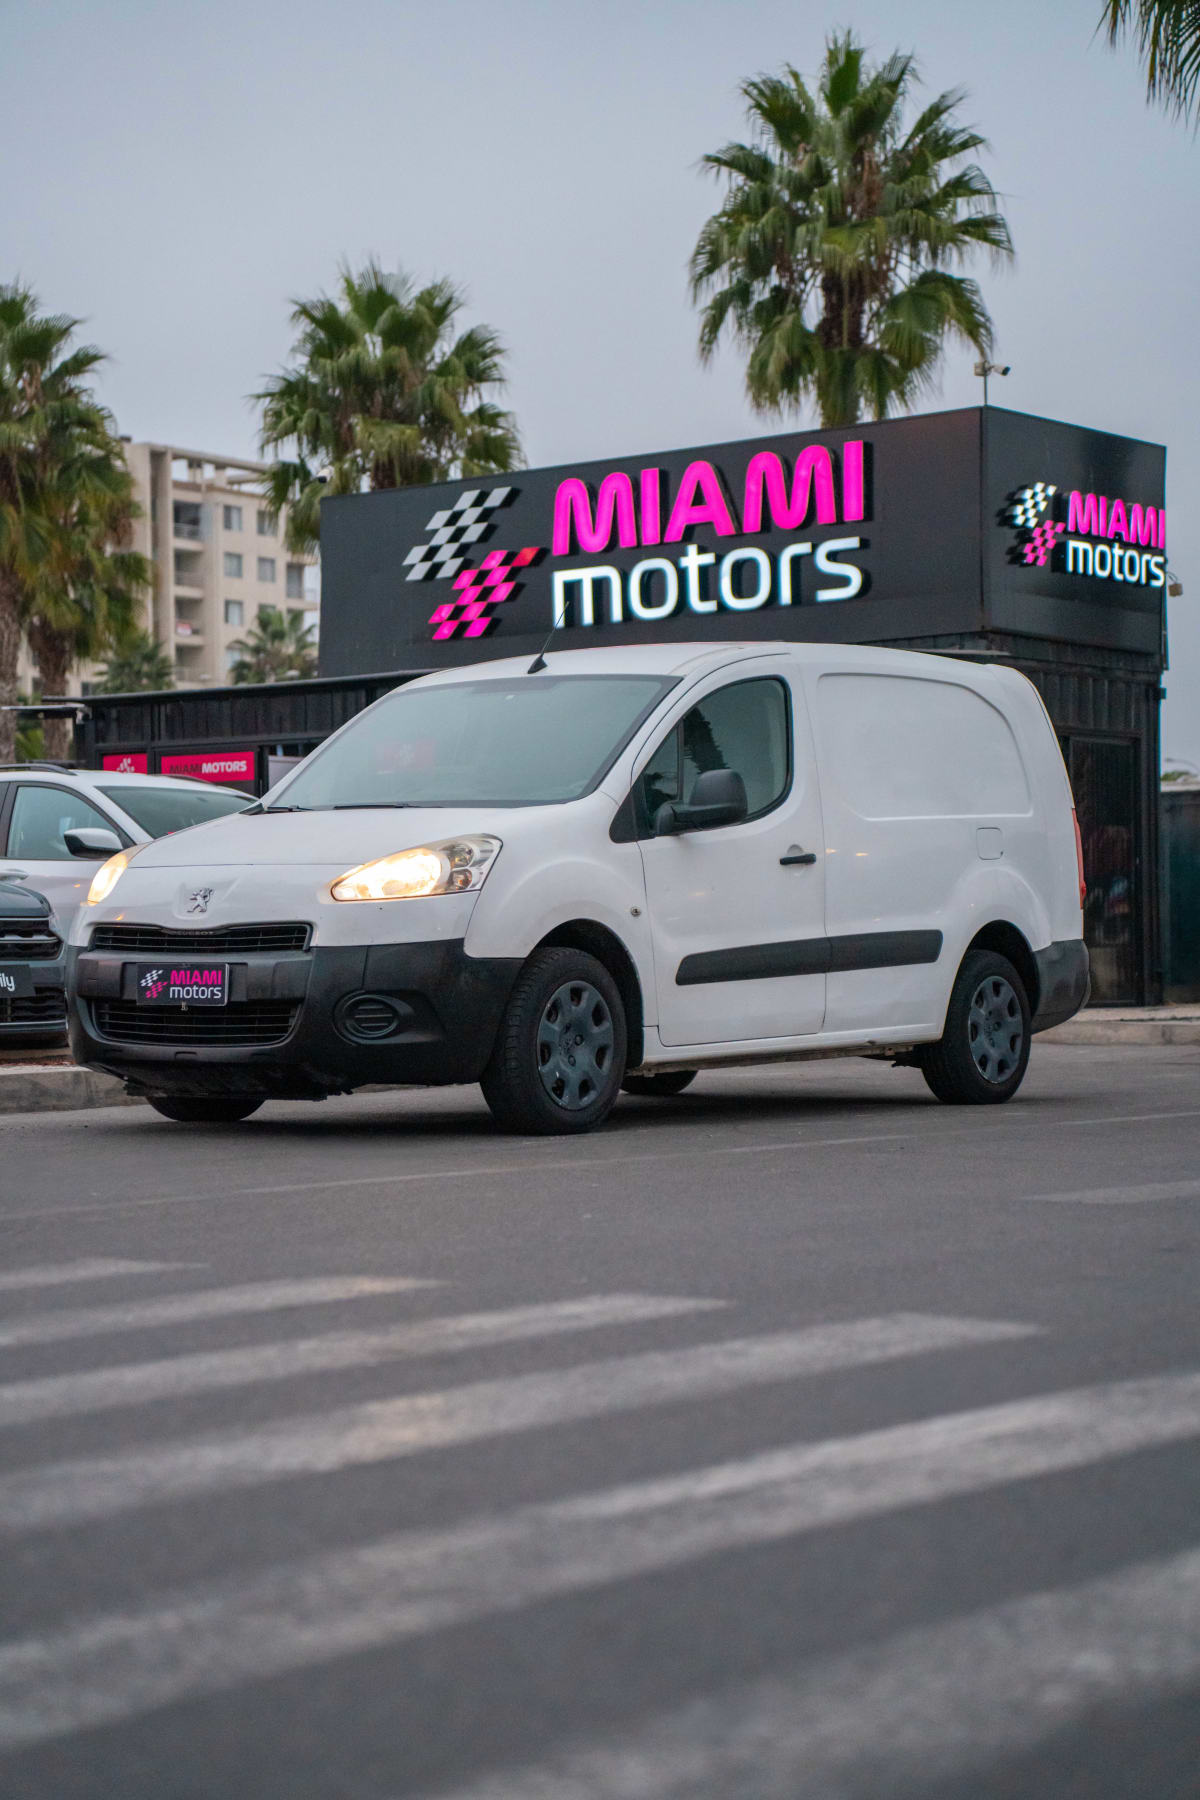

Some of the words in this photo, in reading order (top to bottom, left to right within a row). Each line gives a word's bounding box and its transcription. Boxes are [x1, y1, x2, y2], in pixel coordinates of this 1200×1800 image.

[552, 440, 865, 557] MIAMI
[1067, 490, 1166, 550] MIAMI
[551, 536, 863, 630] motors
[1065, 539, 1165, 588] motors
[201, 760, 247, 774] MOTORS
[169, 969, 222, 985] MIAMI
[169, 984, 222, 999] motors
